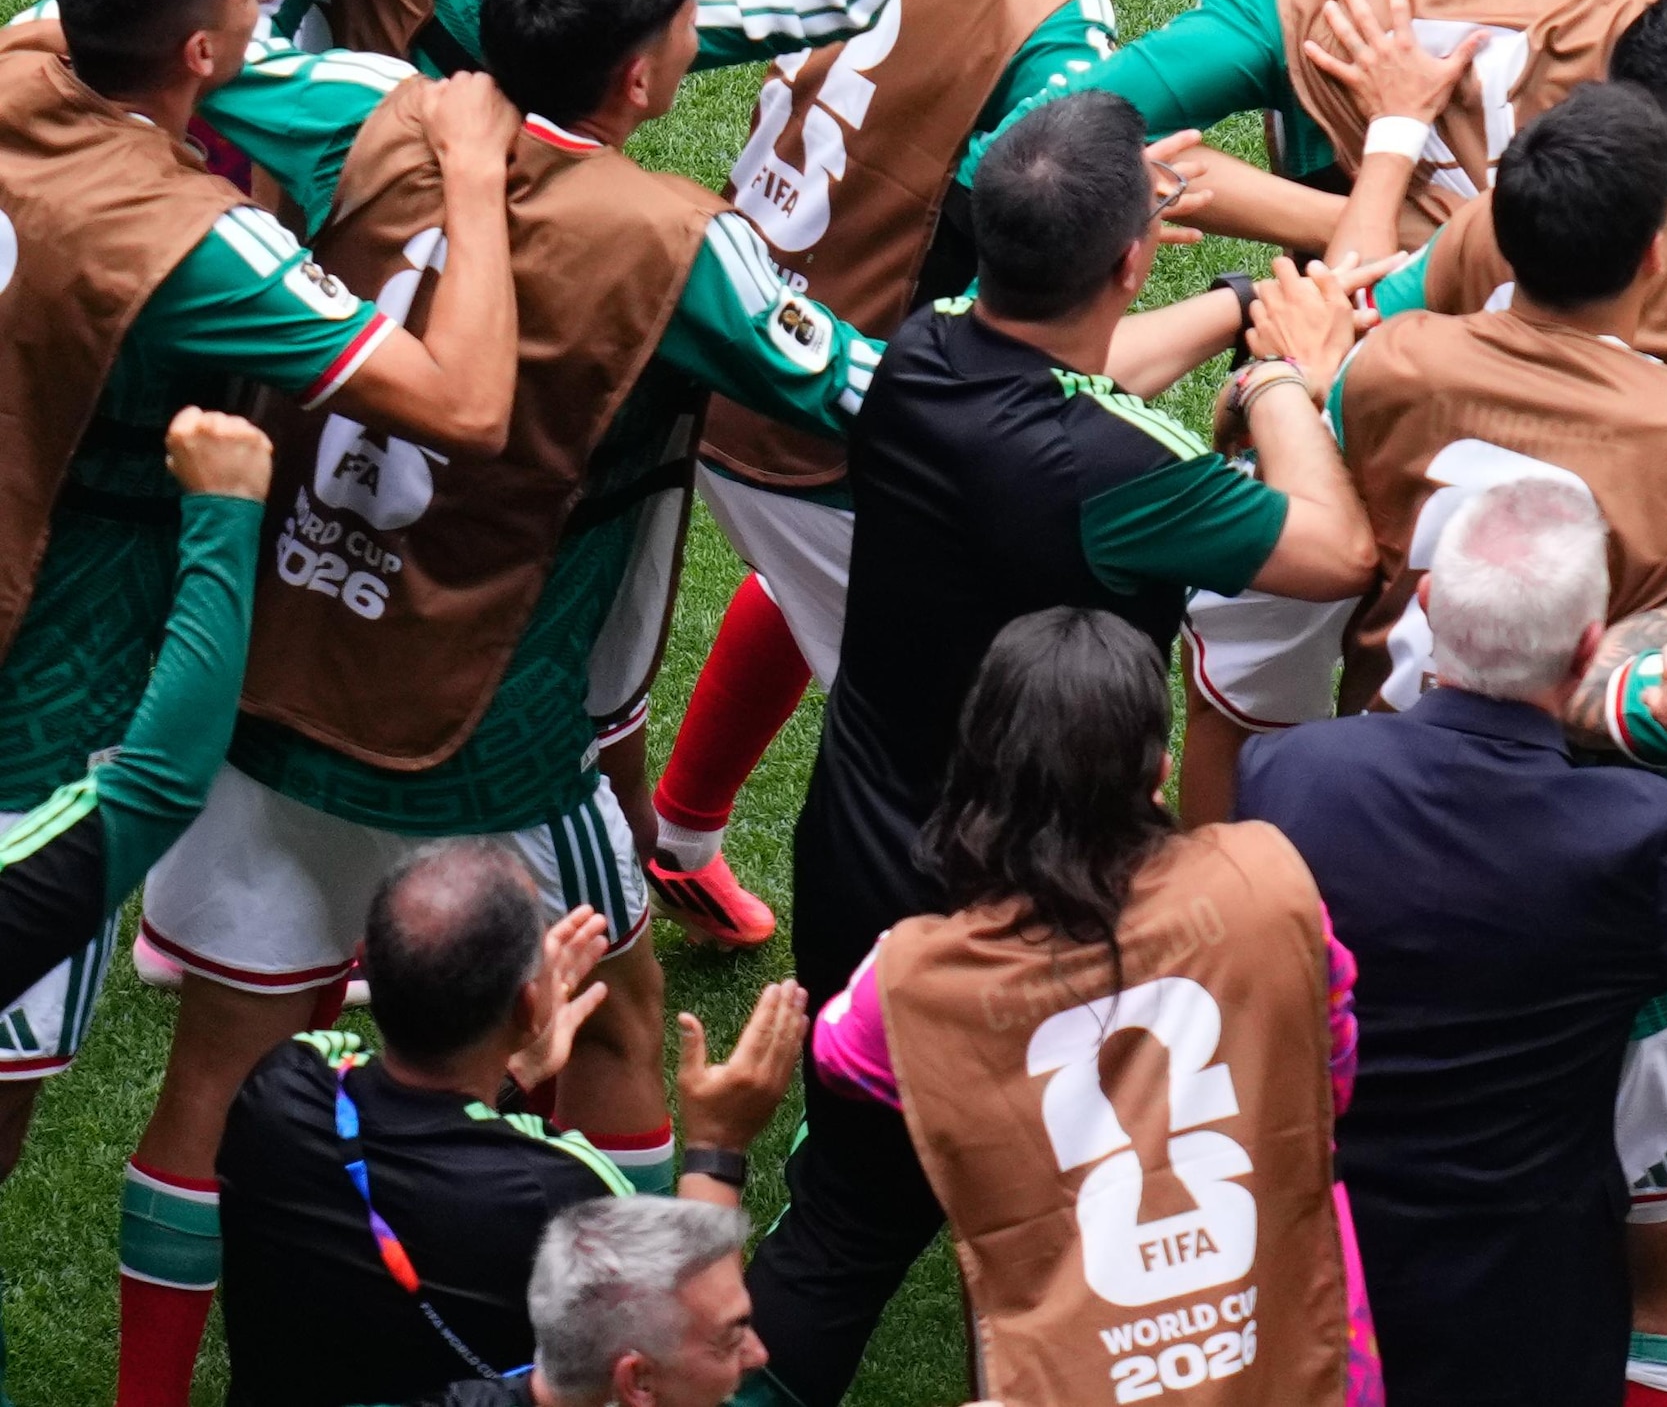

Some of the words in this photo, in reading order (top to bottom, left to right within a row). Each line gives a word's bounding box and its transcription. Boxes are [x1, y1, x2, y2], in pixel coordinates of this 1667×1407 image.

[345, 530, 402, 574] CUP
[1138, 1226, 1221, 1273] FIFA
[1098, 1302, 1219, 1356] WORLD
[1109, 1318, 1258, 1405] 2026
